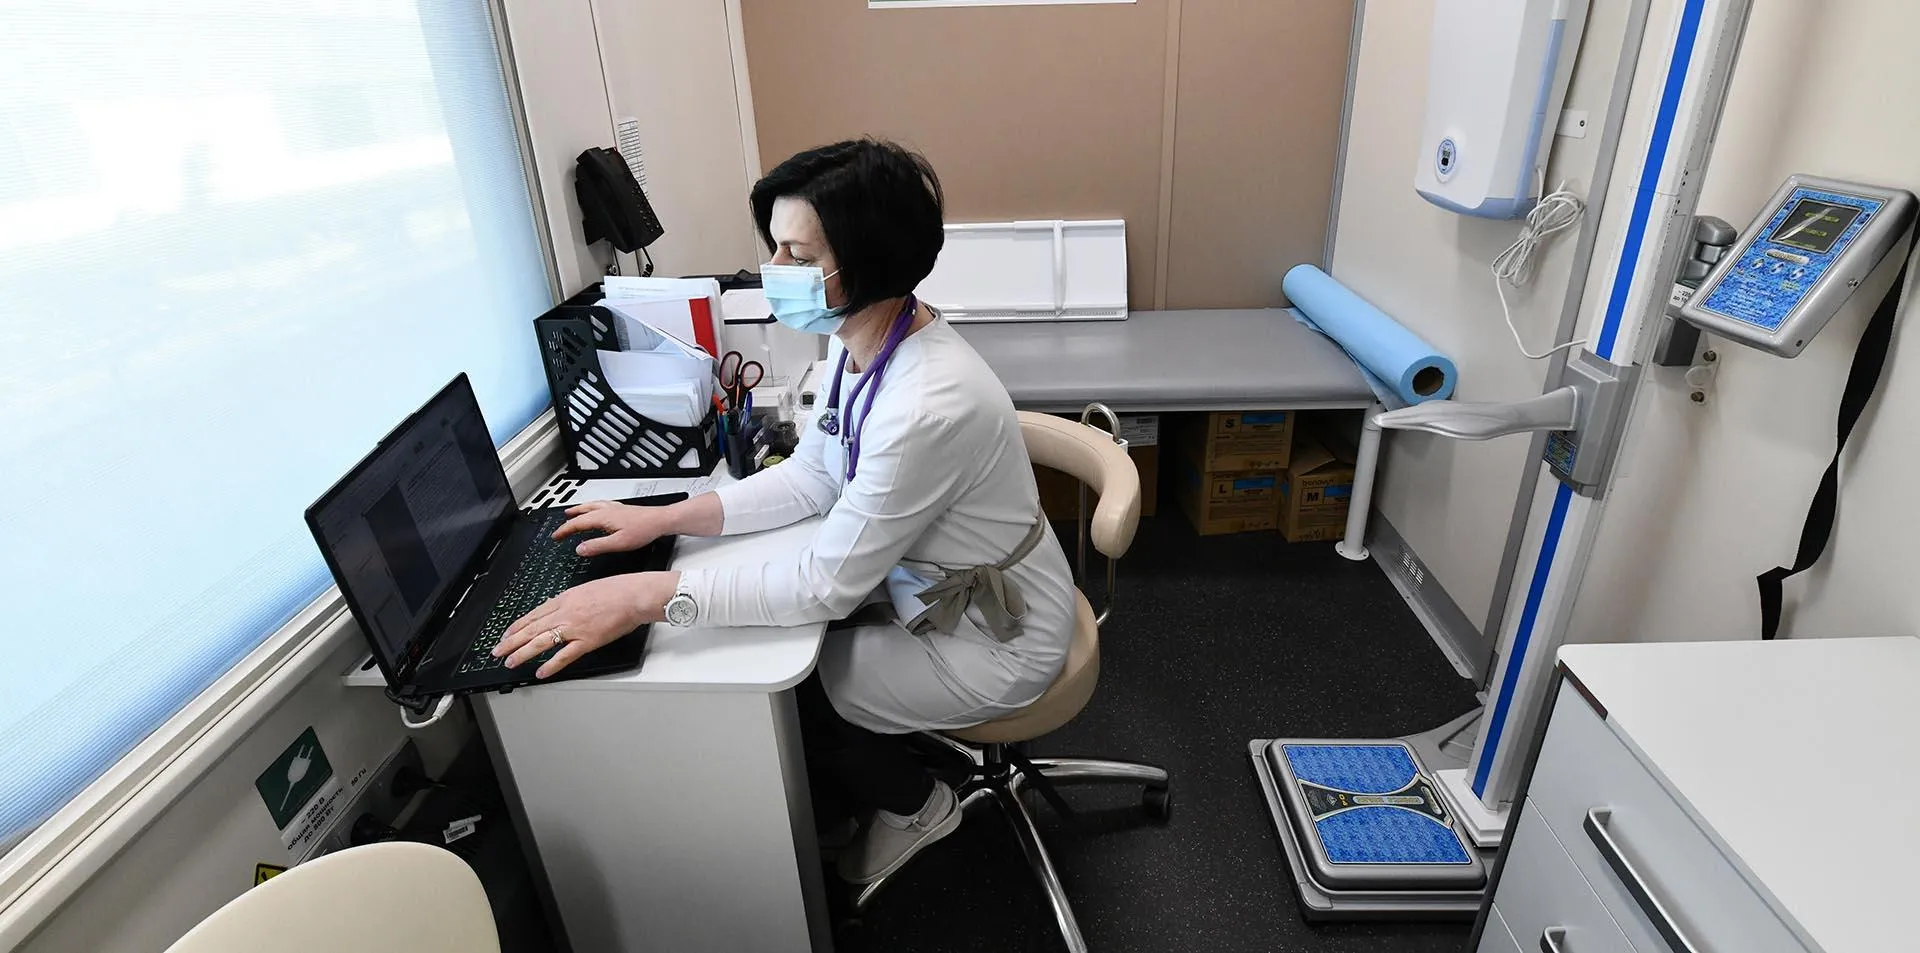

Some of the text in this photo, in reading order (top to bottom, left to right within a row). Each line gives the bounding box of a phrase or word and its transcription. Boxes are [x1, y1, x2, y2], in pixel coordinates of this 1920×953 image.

[1225, 418, 1235, 428] S
[1218, 484, 1227, 494] L
[1307, 492, 1320, 502] M
[306, 803, 319, 819] 220
